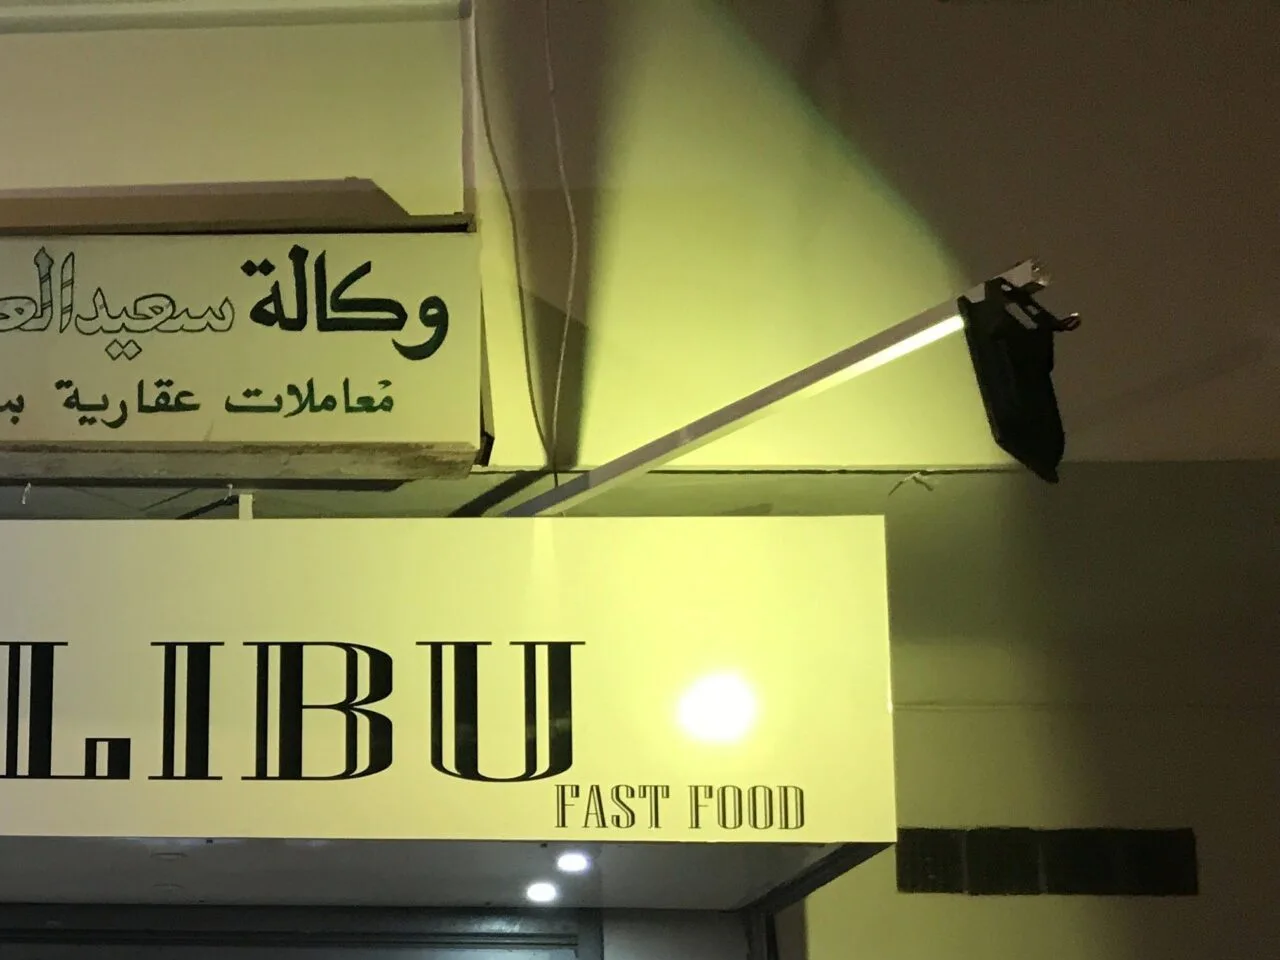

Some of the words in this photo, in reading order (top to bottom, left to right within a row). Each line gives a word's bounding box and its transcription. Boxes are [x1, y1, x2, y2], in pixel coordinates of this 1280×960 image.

[73, 286, 235, 361] سعيد
[240, 243, 449, 361] وكالة
[54, 377, 201, 429] عقارية
[553, 783, 670, 830] FAST
[686, 784, 807, 830] FOOD
